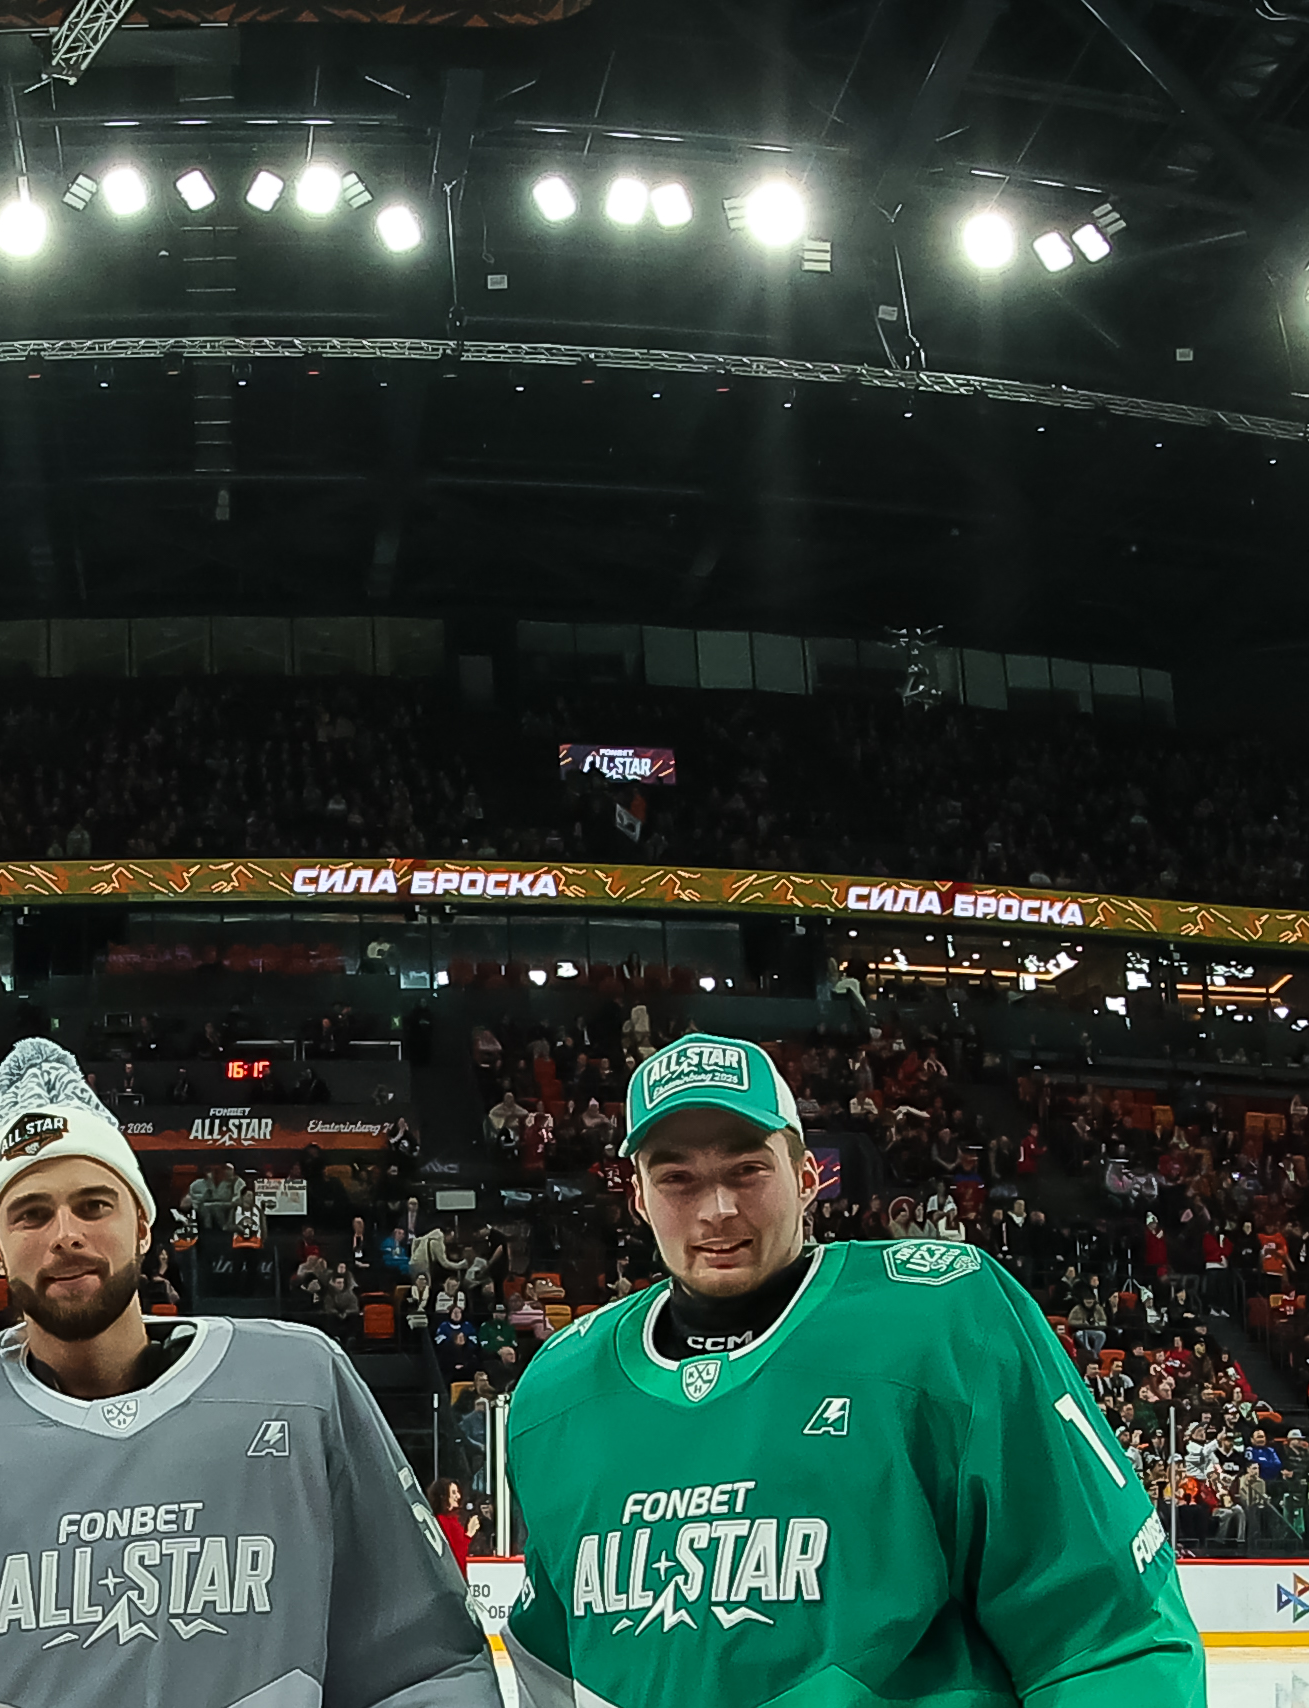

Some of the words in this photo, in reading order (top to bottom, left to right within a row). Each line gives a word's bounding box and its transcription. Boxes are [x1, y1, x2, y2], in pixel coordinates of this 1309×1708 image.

[614, 758, 651, 776] STAR
[293, 868, 397, 894] СИЛА
[410, 870, 558, 897] БРОСКА
[847, 886, 942, 915] СИЛА
[953, 893, 1084, 926] БРОСКА
[649, 1052, 679, 1086] ALL
[687, 1047, 739, 1069] STAR
[1, 1128, 21, 1155] ALL
[26, 1117, 64, 1135] STAR
[126, 1122, 154, 1134] 2026
[189, 1118, 221, 1140] ALL
[228, 1118, 273, 1140] STAR
[307, 1119, 382, 1137] Ekaterinburg
[686, 1329, 754, 1351] CCM
[1054, 1393, 1128, 1489] 1
[622, 1481, 756, 1525] FONBET
[58, 1502, 204, 1546] FONBET
[122, 1535, 276, 1616] STAR
[573, 1527, 654, 1618] ALL
[675, 1517, 829, 1602] STAR
[469, 1584, 491, 1598] ВО
